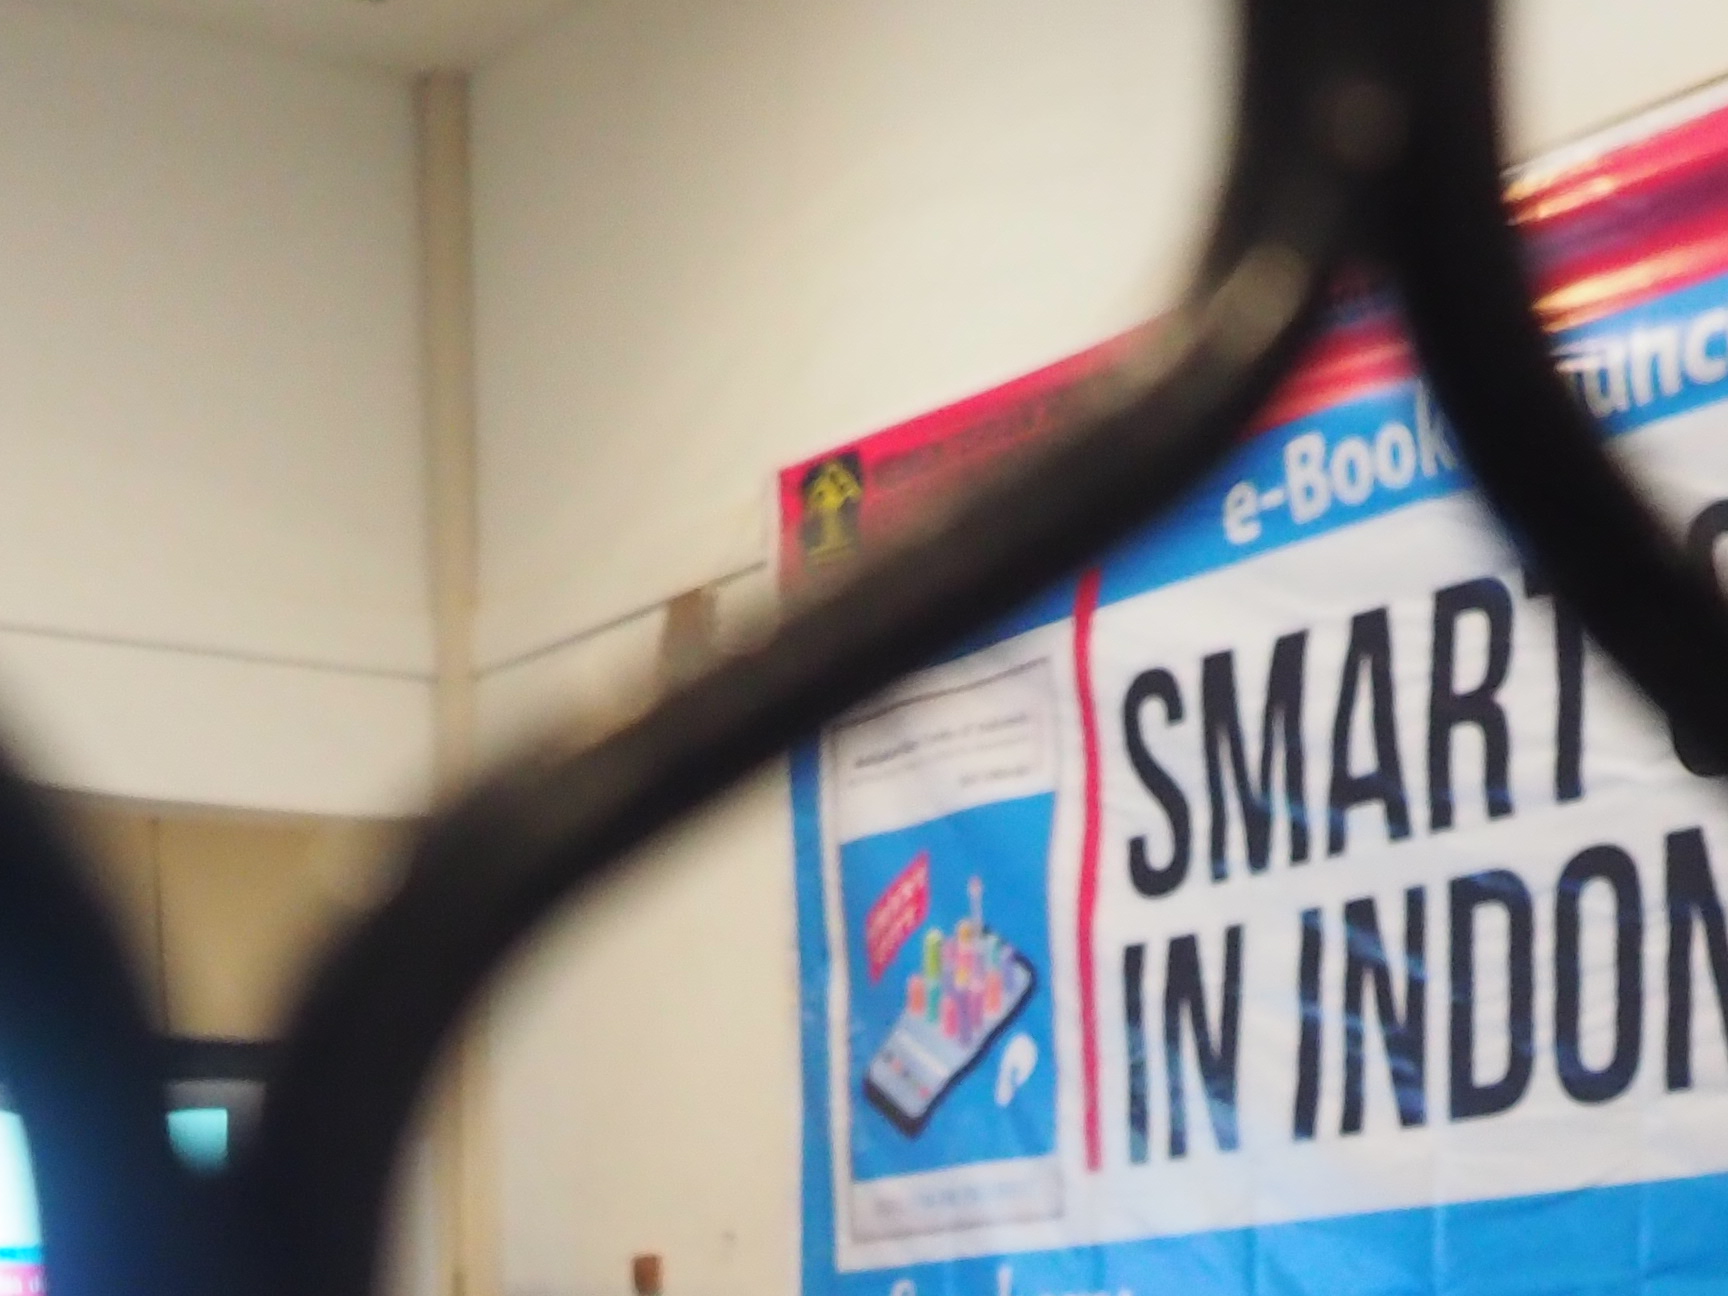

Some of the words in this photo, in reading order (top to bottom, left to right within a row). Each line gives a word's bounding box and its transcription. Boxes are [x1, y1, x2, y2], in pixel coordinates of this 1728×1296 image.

[1222, 380, 1458, 545] e-Book
[1122, 566, 1586, 898] SMART
[1122, 926, 1245, 1167] IN
